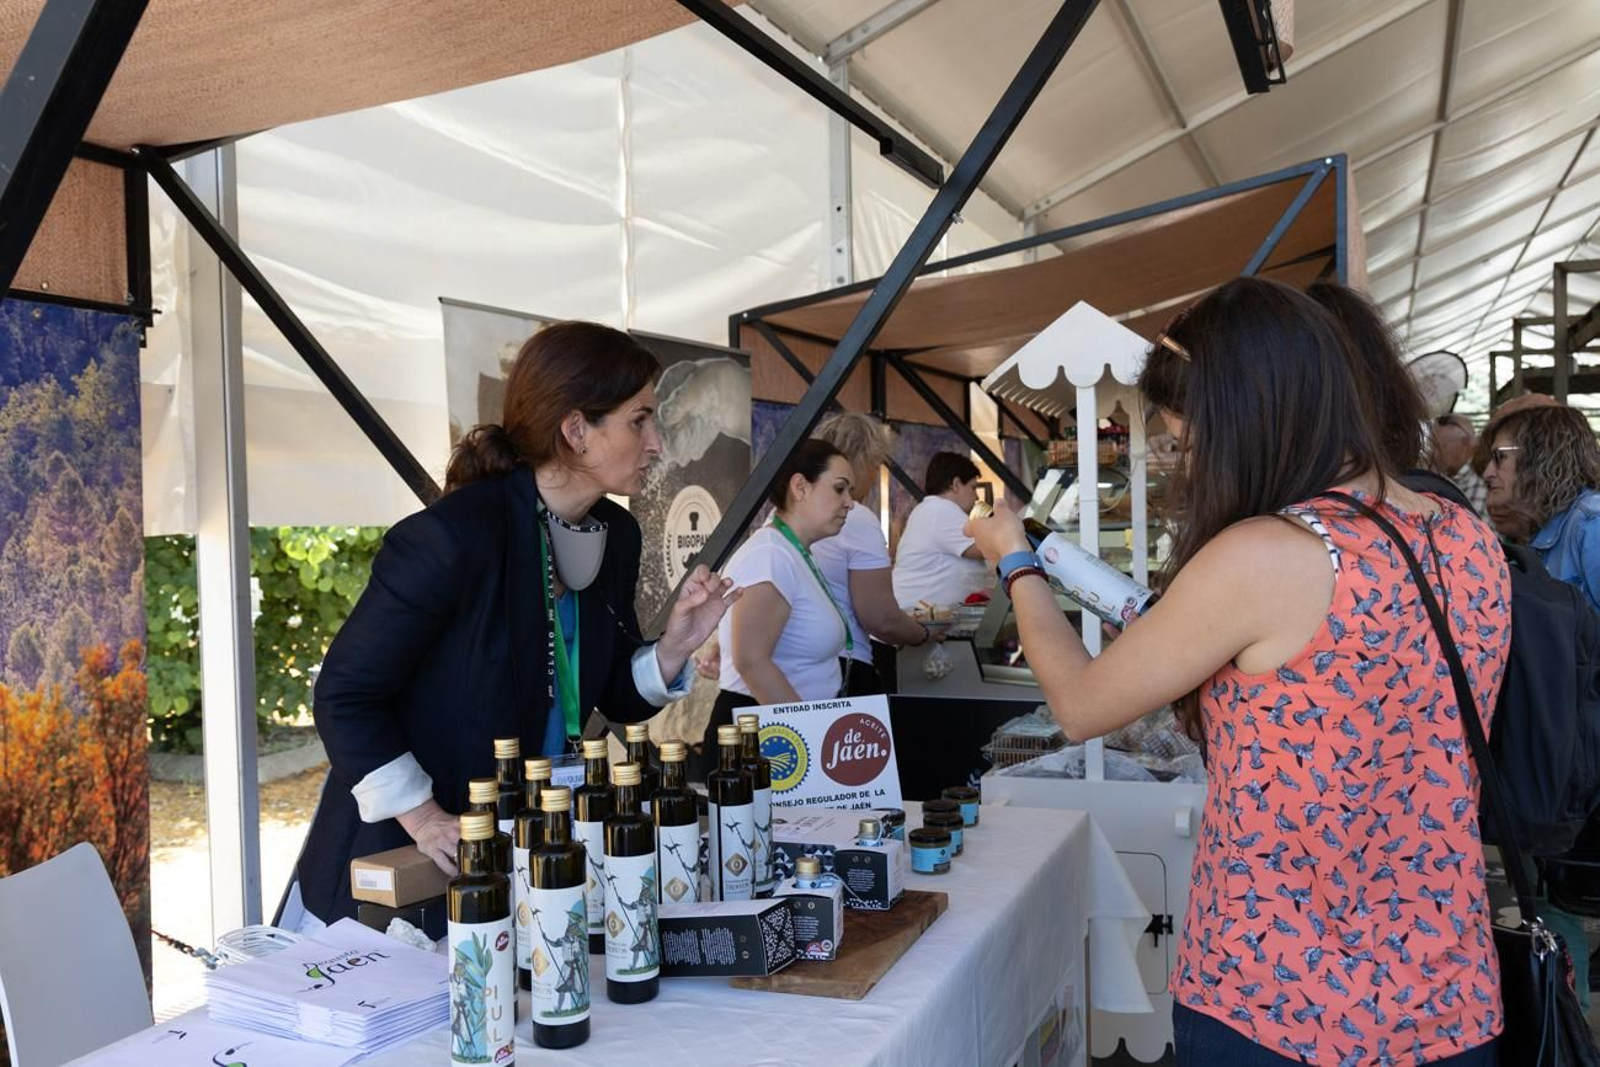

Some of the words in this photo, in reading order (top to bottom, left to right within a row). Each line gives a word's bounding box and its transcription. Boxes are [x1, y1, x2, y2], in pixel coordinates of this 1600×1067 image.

[547, 555, 555, 598] CLARO
[773, 704, 811, 715] ENTIDAD
[812, 700, 852, 711] INSCRITA
[843, 727, 862, 744] de
[860, 718, 888, 739] ACEITE
[769, 798, 804, 809] ONSEJO
[806, 791, 858, 806] REGULADOR
[859, 790, 870, 799] DE
[874, 788, 886, 797] LA
